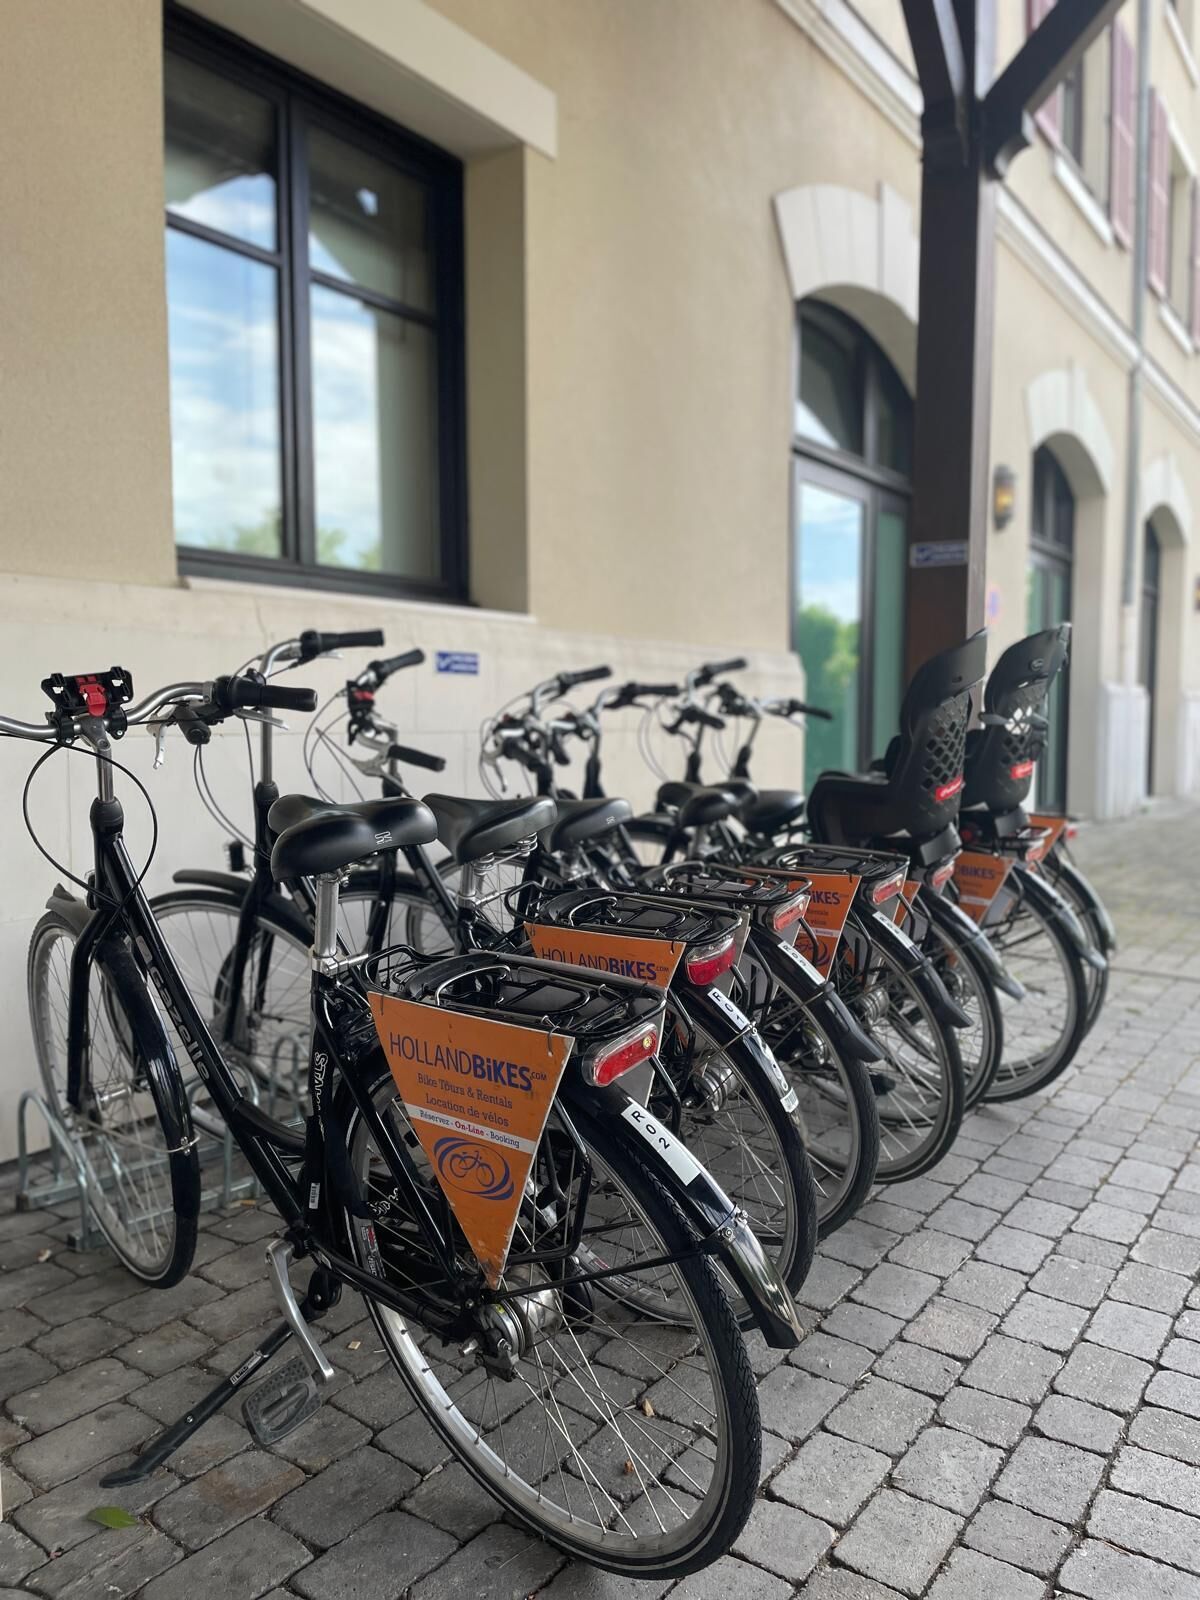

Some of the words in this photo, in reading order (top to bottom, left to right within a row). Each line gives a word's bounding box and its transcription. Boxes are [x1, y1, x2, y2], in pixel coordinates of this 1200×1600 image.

[150, 966, 210, 1081] Gazelle
[417, 1072, 438, 1089] Bike
[439, 1079, 465, 1096] Tours
[466, 1086, 475, 1099] &
[476, 1088, 513, 1110] Rentals
[425, 1092, 465, 1115] Location
[467, 1105, 480, 1118] de
[481, 1110, 510, 1128] vélos
[419, 1109, 451, 1127] Réservez
[454, 1120, 485, 1137] On-Line
[489, 1130, 520, 1148] Booking
[631, 1108, 671, 1149] R02
